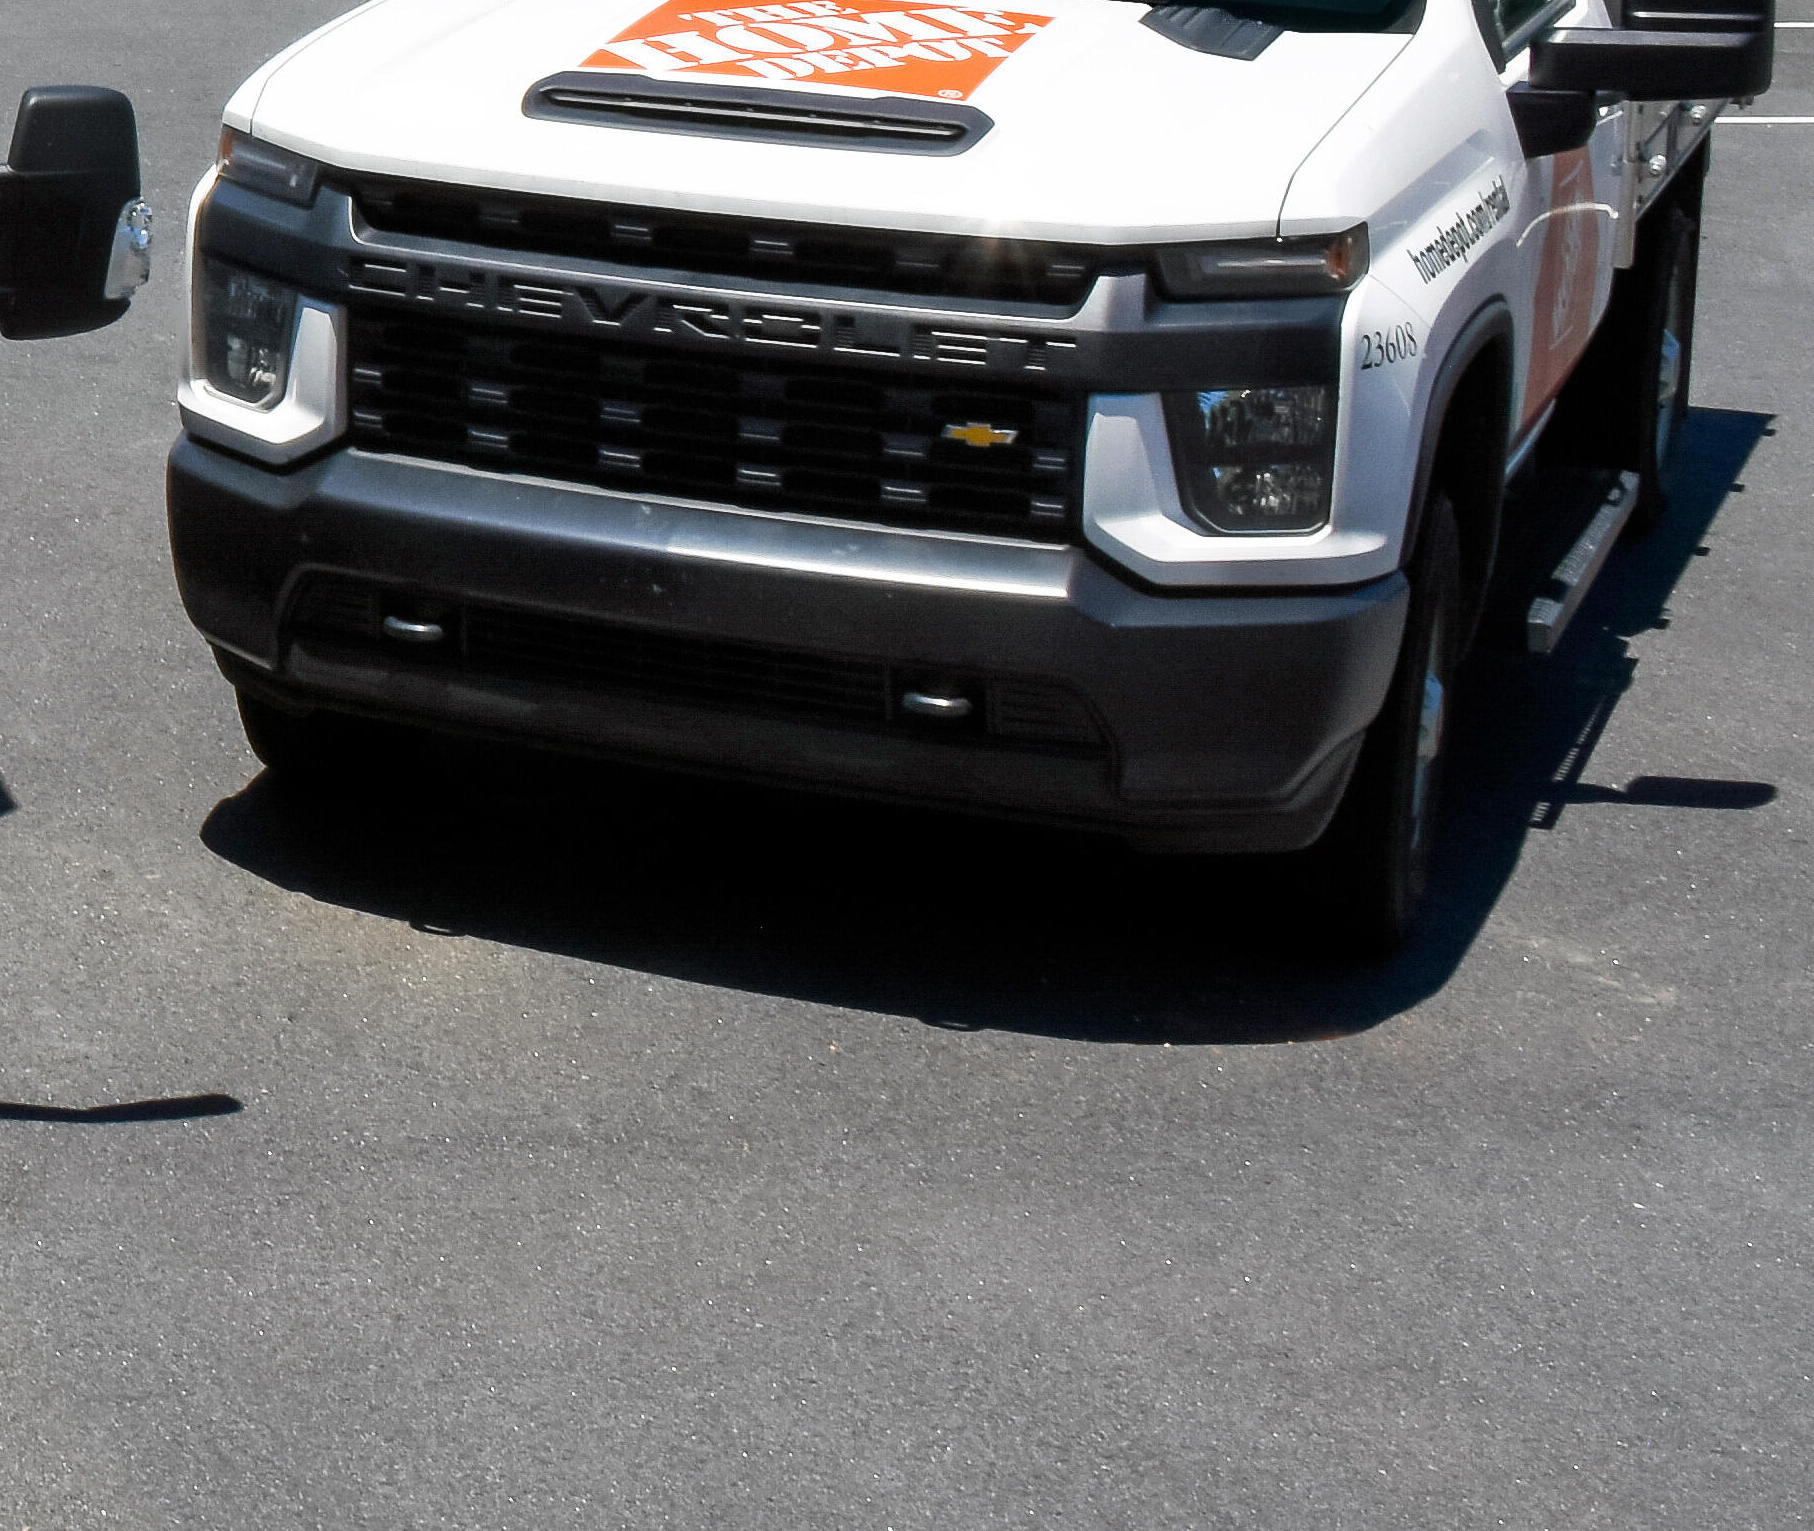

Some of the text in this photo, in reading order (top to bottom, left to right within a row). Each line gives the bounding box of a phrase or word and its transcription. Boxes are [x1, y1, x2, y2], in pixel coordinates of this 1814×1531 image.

[678, 0, 862, 27] THE
[604, 6, 1047, 71] HOME
[737, 36, 1014, 80] DEPOT
[345, 261, 1078, 371] CHEVROLET
[1360, 321, 1418, 370] 23608
